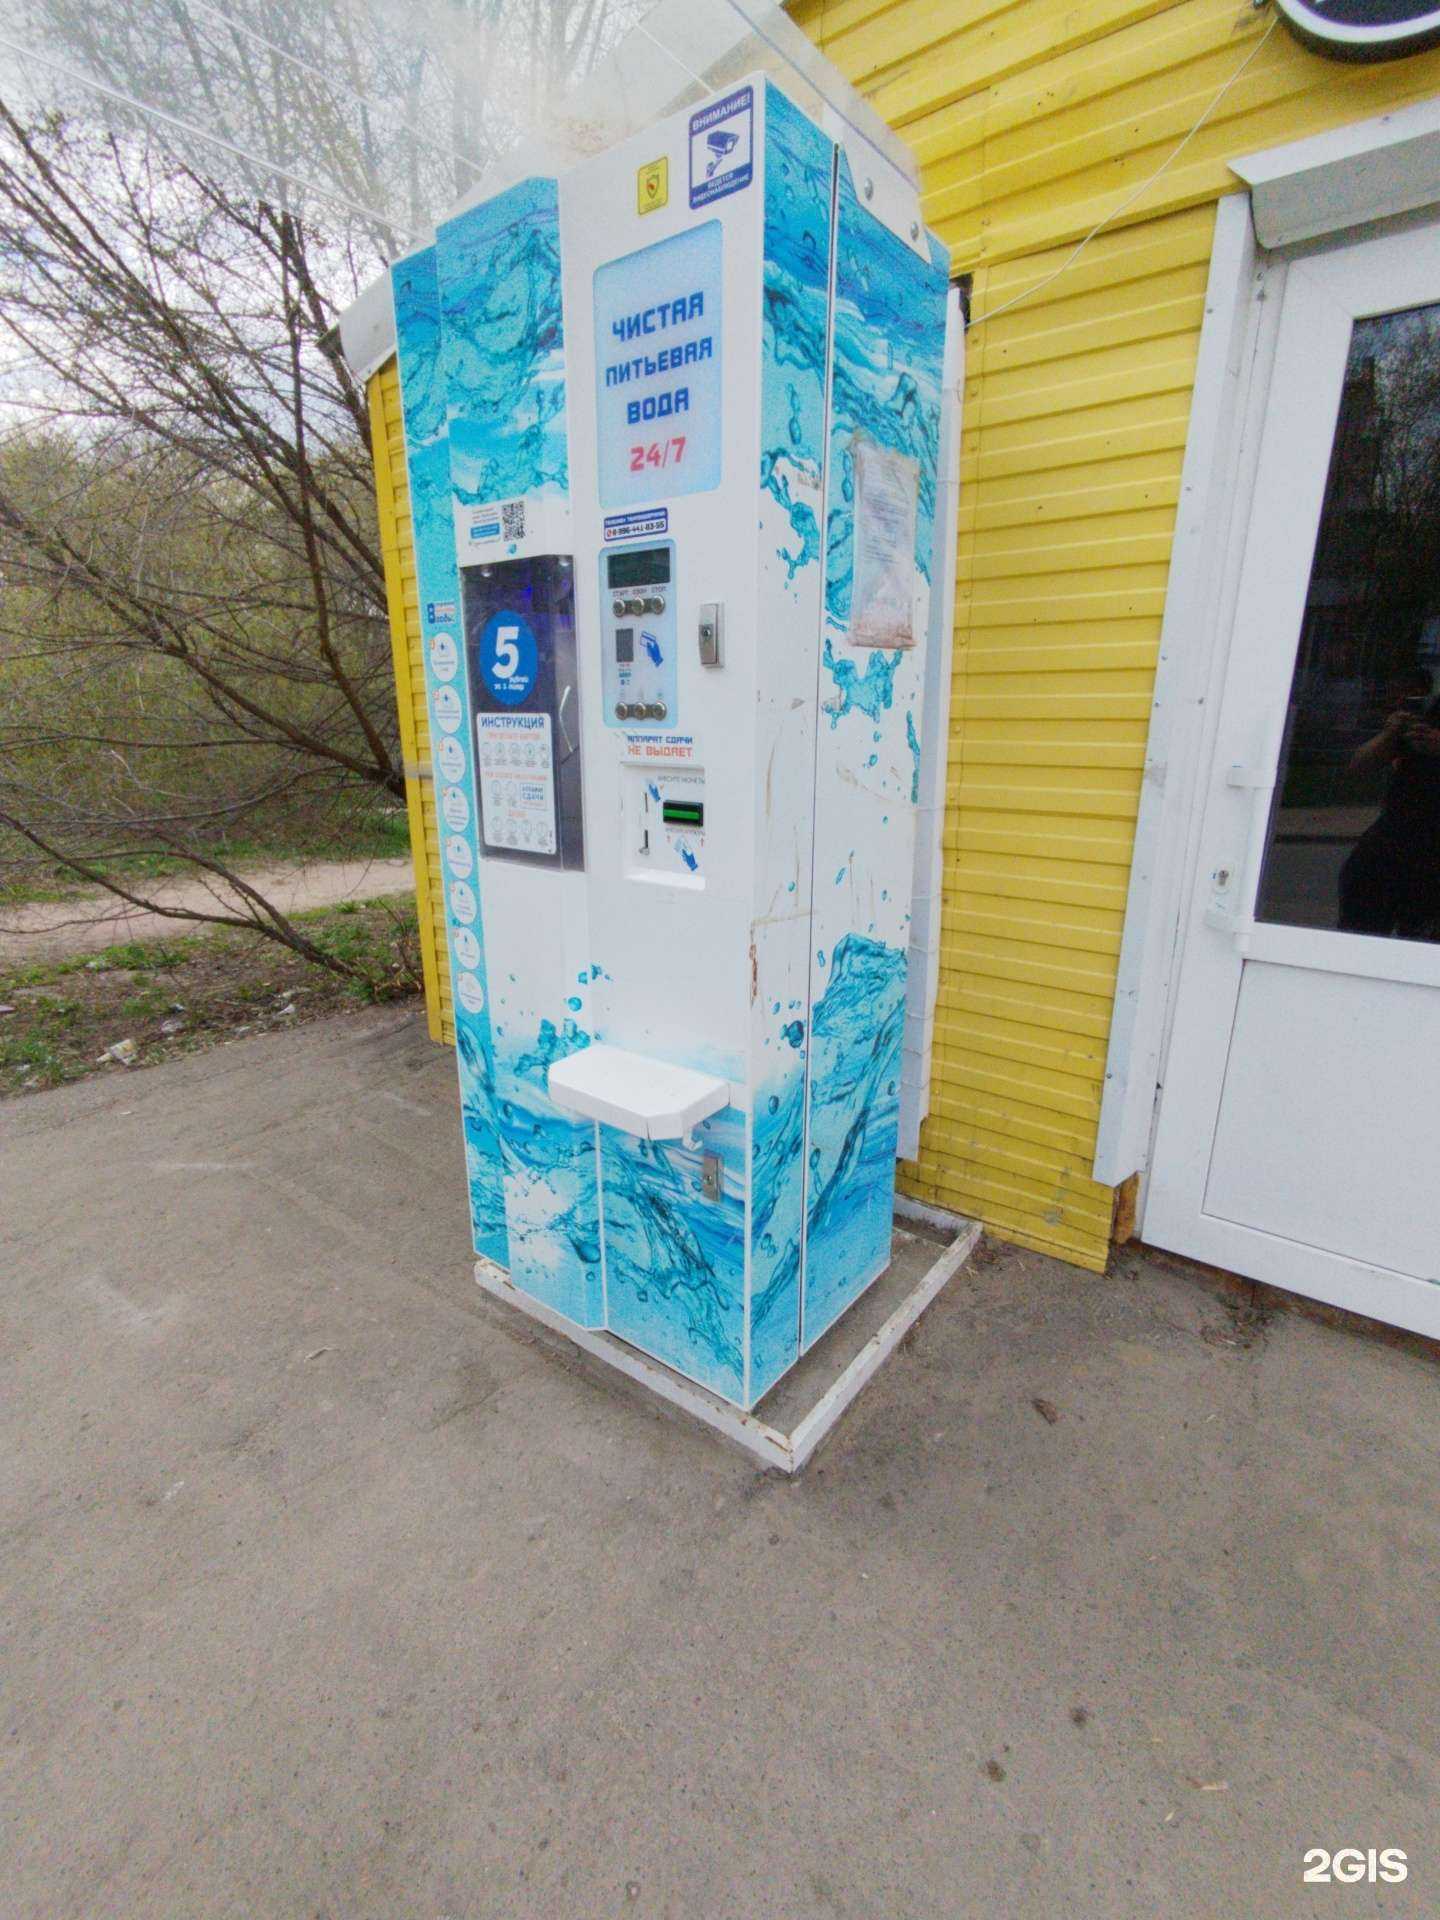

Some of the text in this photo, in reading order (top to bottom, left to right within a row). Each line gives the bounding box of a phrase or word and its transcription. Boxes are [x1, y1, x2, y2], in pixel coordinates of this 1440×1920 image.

[692, 94, 751, 131] ВНИМАНИЕ!
[612, 291, 704, 342] ЧИСТАЯ
[606, 336, 712, 387] ПИТЬЕВАЯ
[627, 388, 690, 425] ВОДА
[630, 437, 687, 472] 24/7
[491, 626, 519, 679] 5
[481, 716, 545, 730] ИНСТРУКЦИЯ
[627, 736, 693, 744] АППАРАТ СДАЧИ
[628, 746, 693, 757] НЕ ВЫДАЕТ
